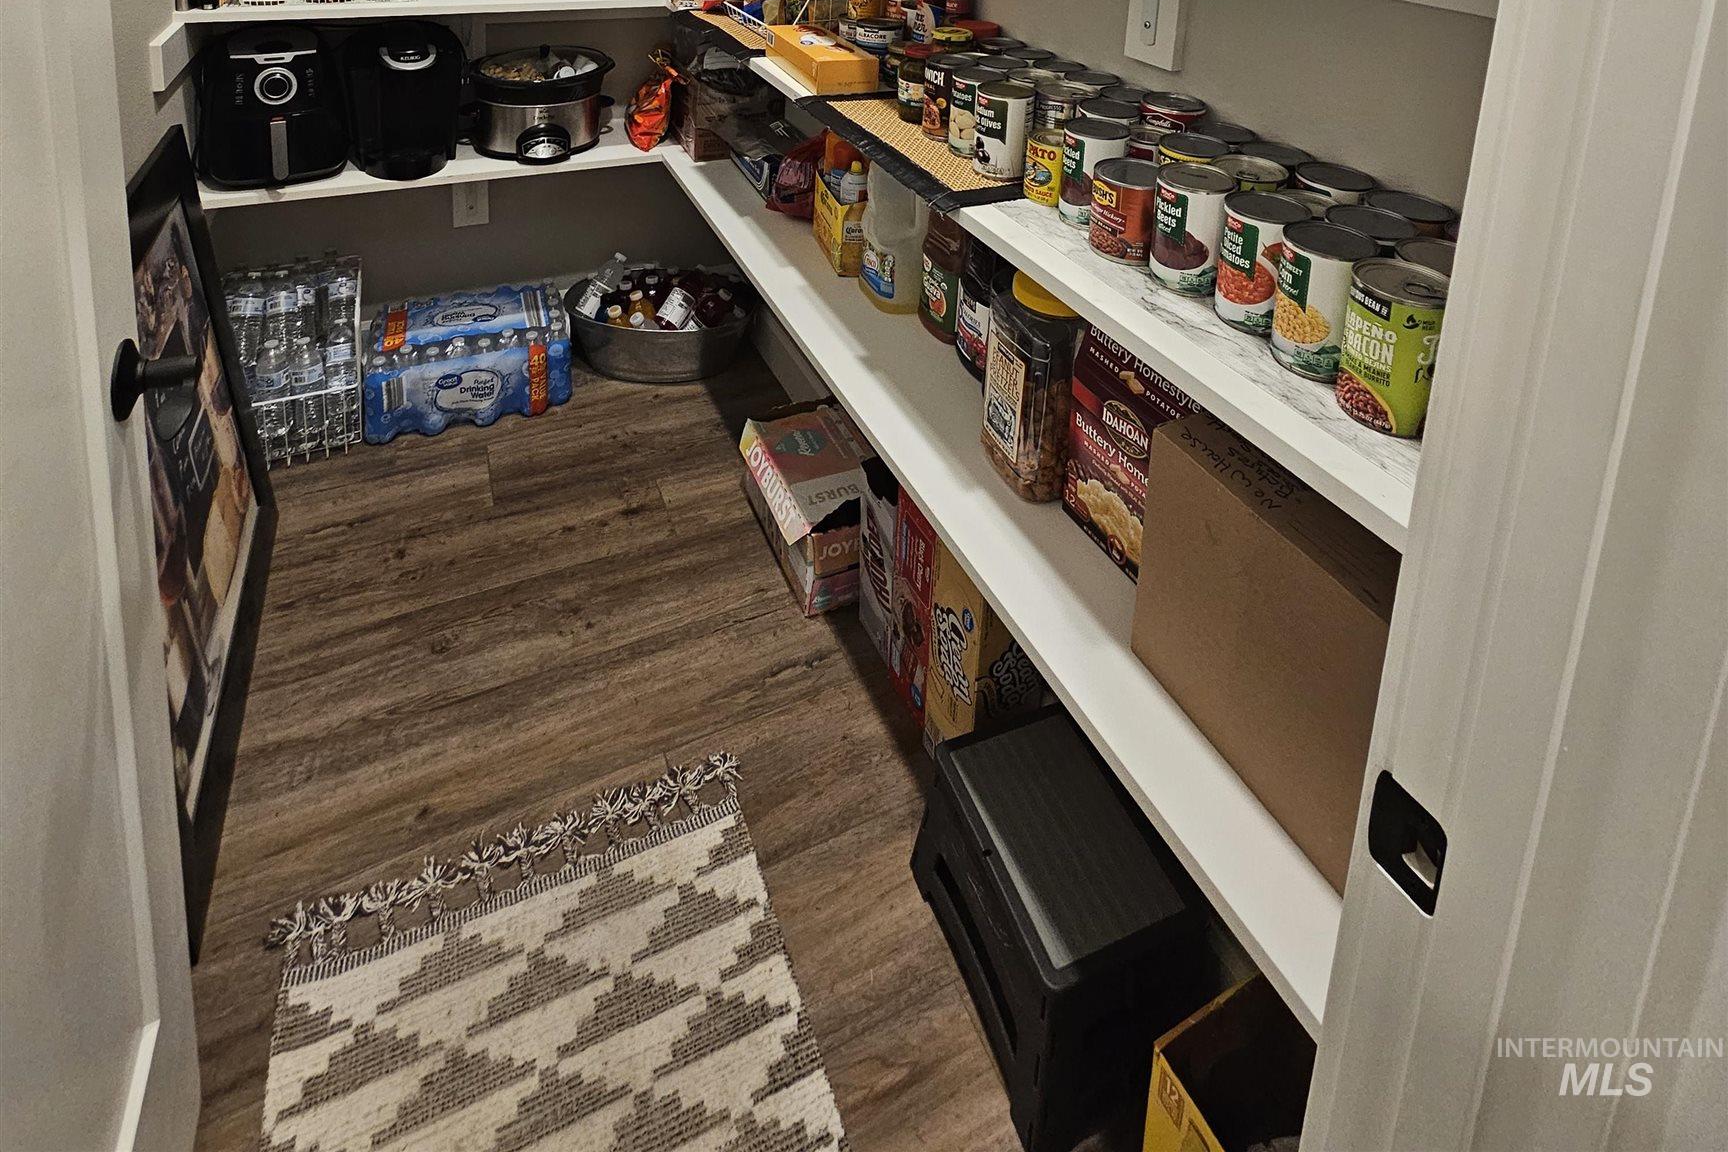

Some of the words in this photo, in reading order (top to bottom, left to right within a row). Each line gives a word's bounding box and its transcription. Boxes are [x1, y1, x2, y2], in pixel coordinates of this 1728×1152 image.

[981, 117, 1001, 130] Olives
[1156, 196, 1182, 218] Pickled
[1157, 208, 1177, 228] Beets
[1224, 227, 1244, 245] Petite
[1365, 296, 1381, 315] BEAN
[530, 353, 546, 366] 40
[1089, 347, 1119, 373] MASHED
[1090, 325, 1133, 364] Buttery
[1134, 358, 1200, 414] Homestyle
[1364, 365, 1391, 380] MEANIER
[459, 384, 495, 395] Drinking
[1364, 373, 1391, 387] BURRITO
[470, 390, 495, 399] Water
[1076, 412, 1116, 457] Buttery
[1103, 408, 1150, 450] IDAHOAN
[1083, 440, 1110, 466] MASHED
[746, 444, 795, 529] JOYBURST
[808, 484, 859, 506] BURST
[1065, 489, 1077, 508] 12
